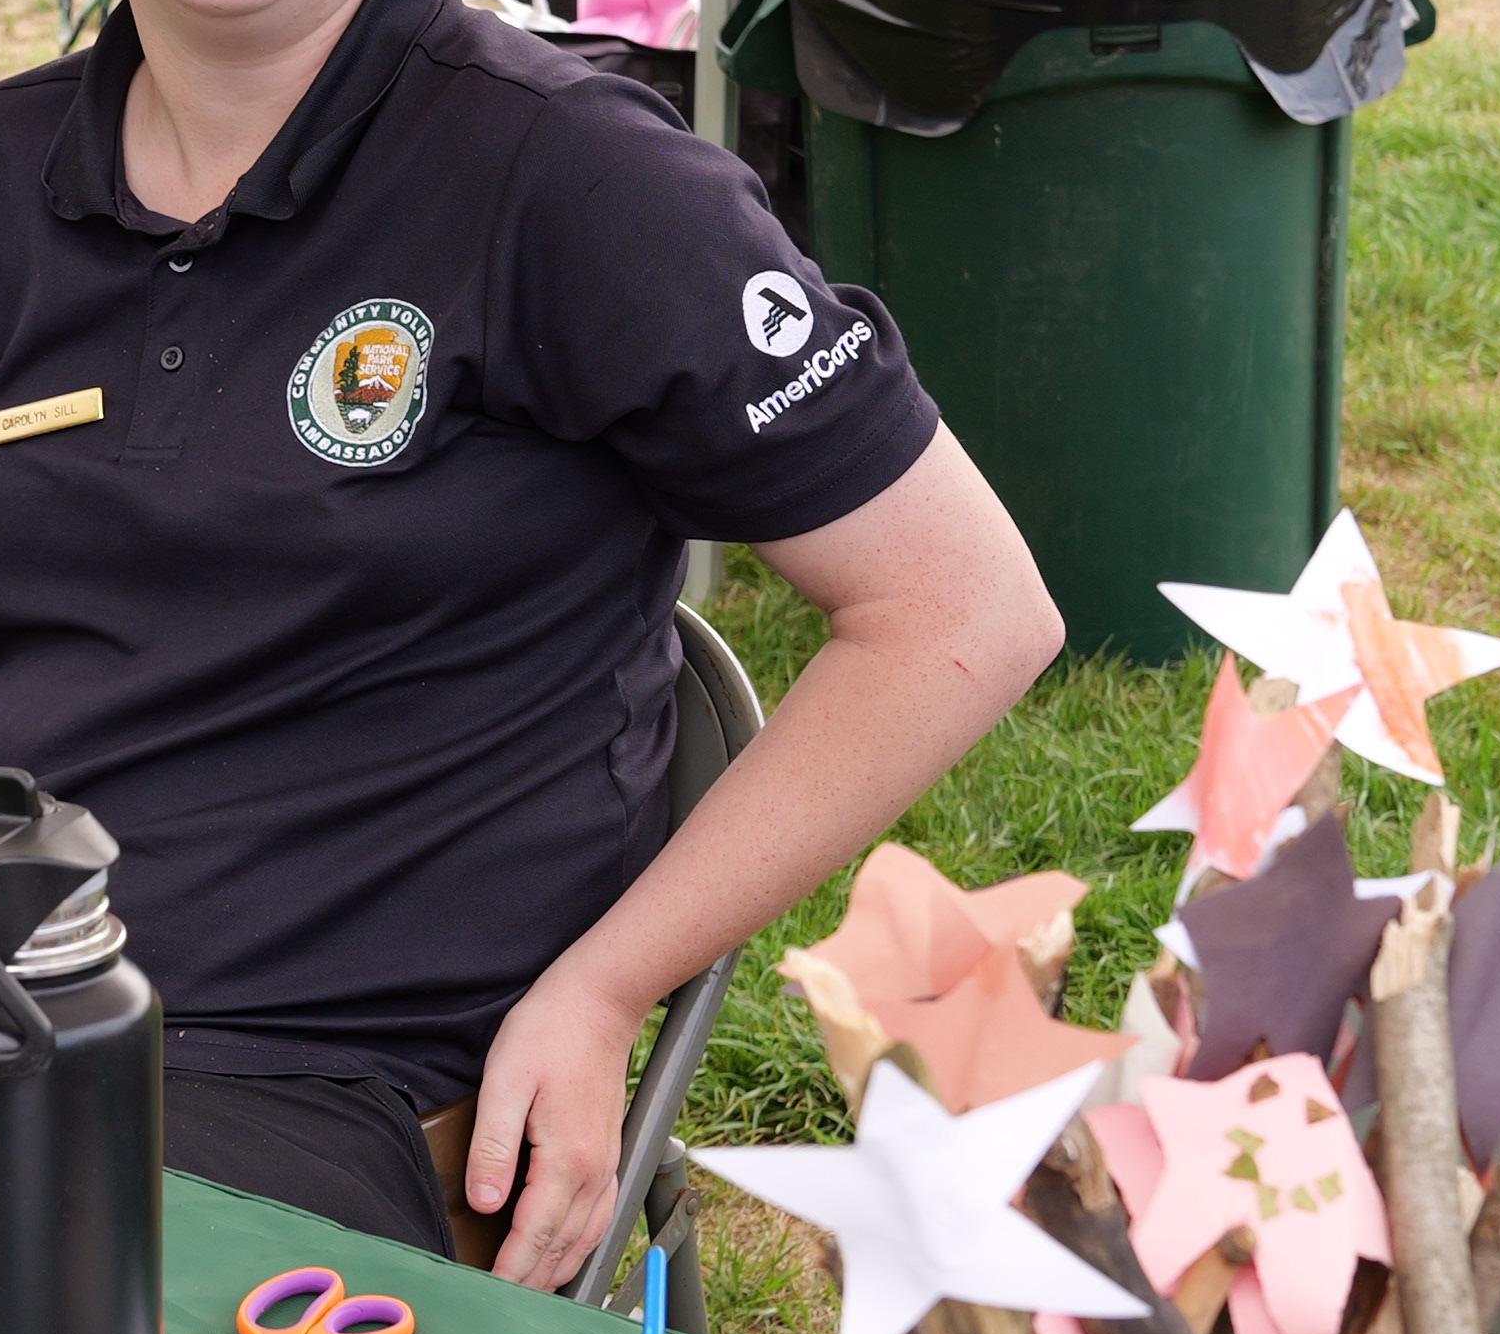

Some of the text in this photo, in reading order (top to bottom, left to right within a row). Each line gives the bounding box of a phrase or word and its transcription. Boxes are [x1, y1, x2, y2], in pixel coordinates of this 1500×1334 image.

[291, 304, 382, 400] COMMUNITY
[361, 343, 409, 357] NATIONAL
[367, 354, 395, 365] PARK
[359, 364, 402, 376] SERVICE
[745, 320, 872, 435] AmeriCorps
[1, 404, 78, 431] CAROLYN SILL
[297, 418, 412, 461] AMBASSADOR
